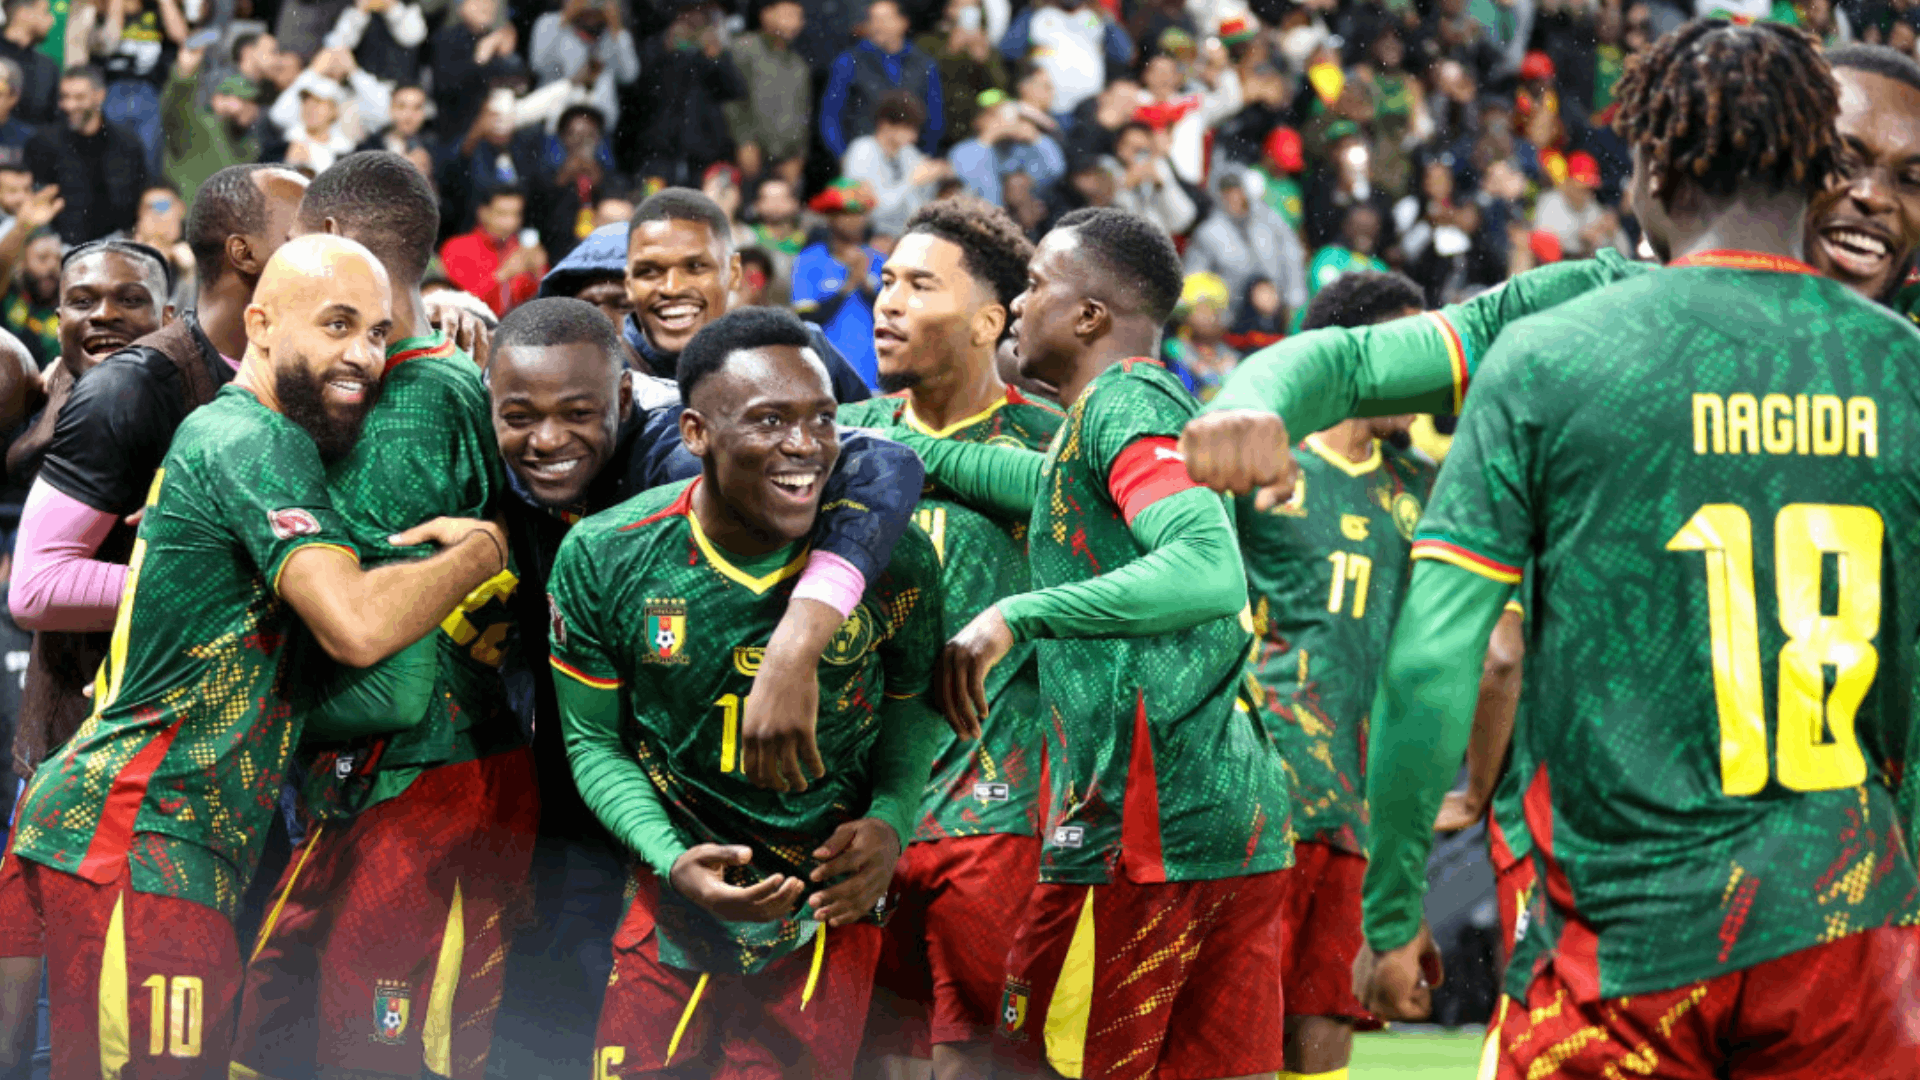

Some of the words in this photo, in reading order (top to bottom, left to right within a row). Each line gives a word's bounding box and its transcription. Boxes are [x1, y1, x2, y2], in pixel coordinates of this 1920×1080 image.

[1692, 393, 1879, 458] NAGIDA
[1328, 550, 1372, 619] 17
[1665, 502, 1885, 797] 18
[713, 692, 748, 774] 1
[141, 973, 204, 1058] 10
